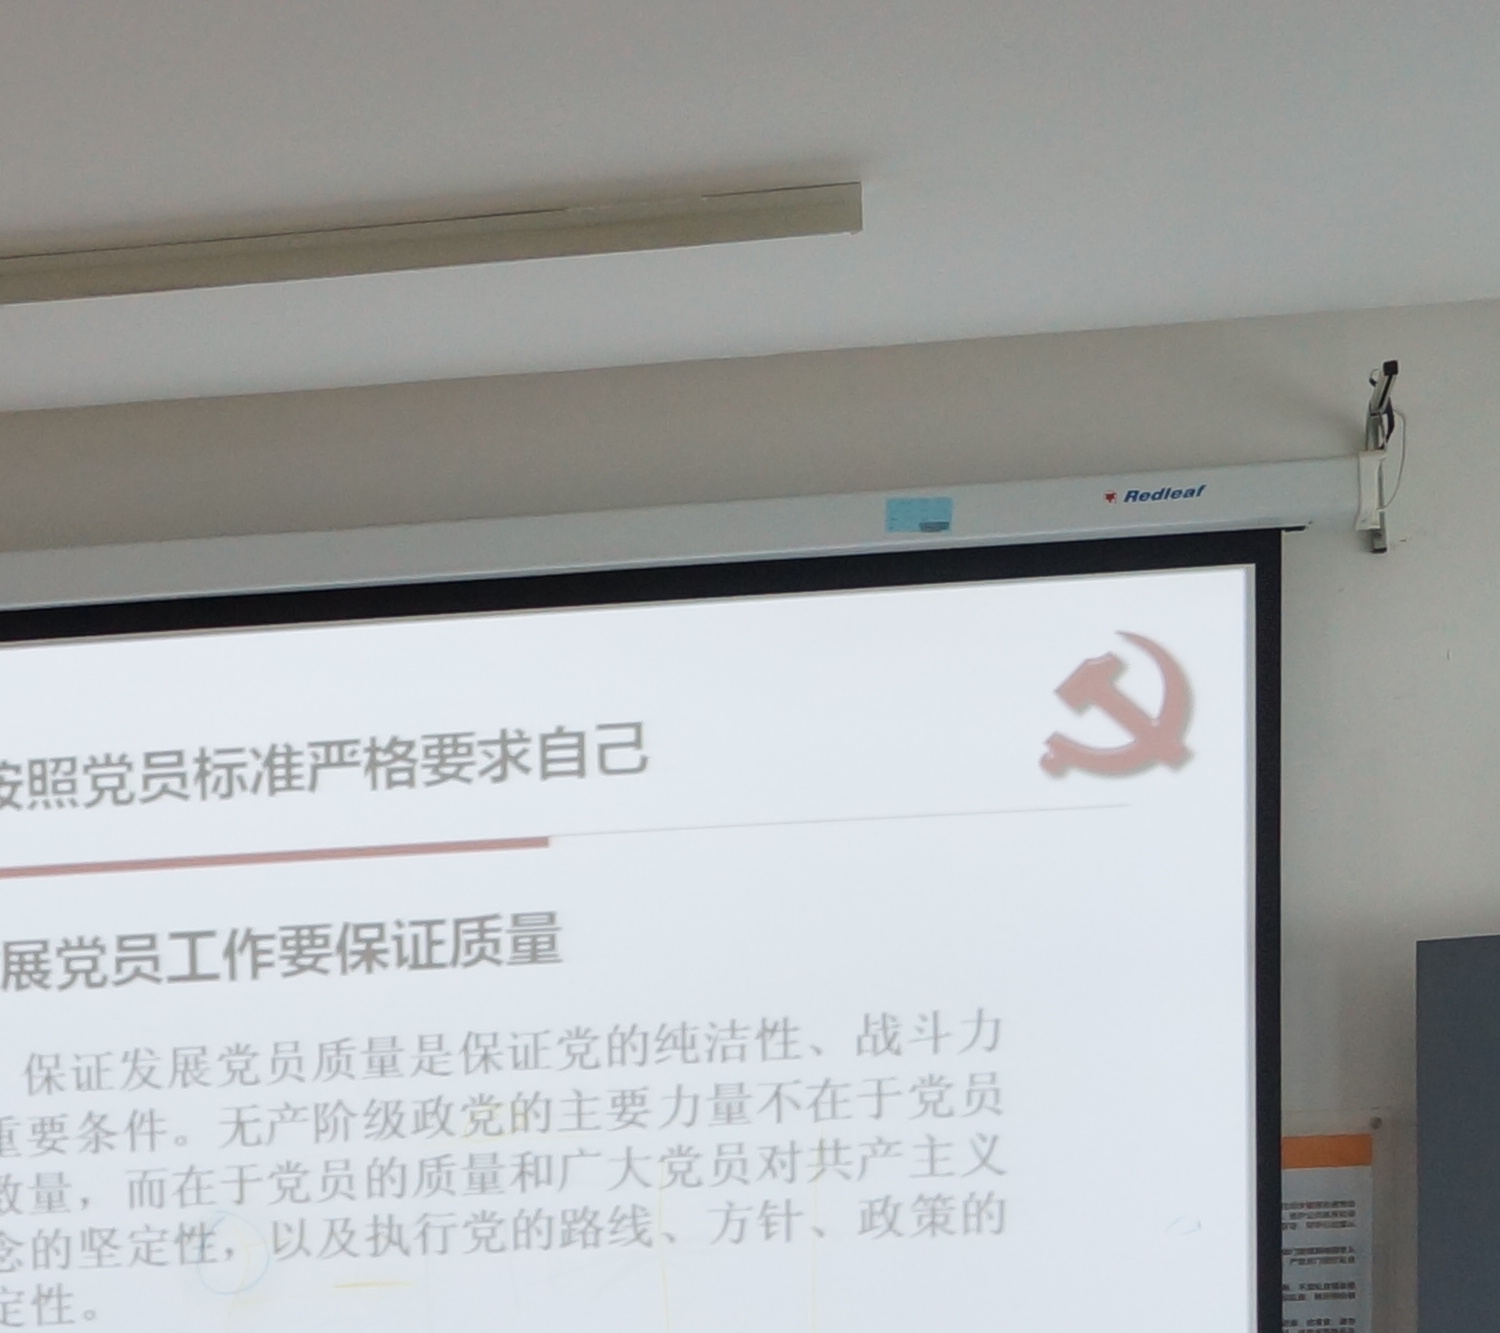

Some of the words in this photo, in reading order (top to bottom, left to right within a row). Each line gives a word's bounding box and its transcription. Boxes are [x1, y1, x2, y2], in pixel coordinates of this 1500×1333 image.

[1123, 483, 1207, 503] Redleaf
[22, 1007, 1002, 1097] 保证发展党员质量是保证党的纯洁性、战斗力
